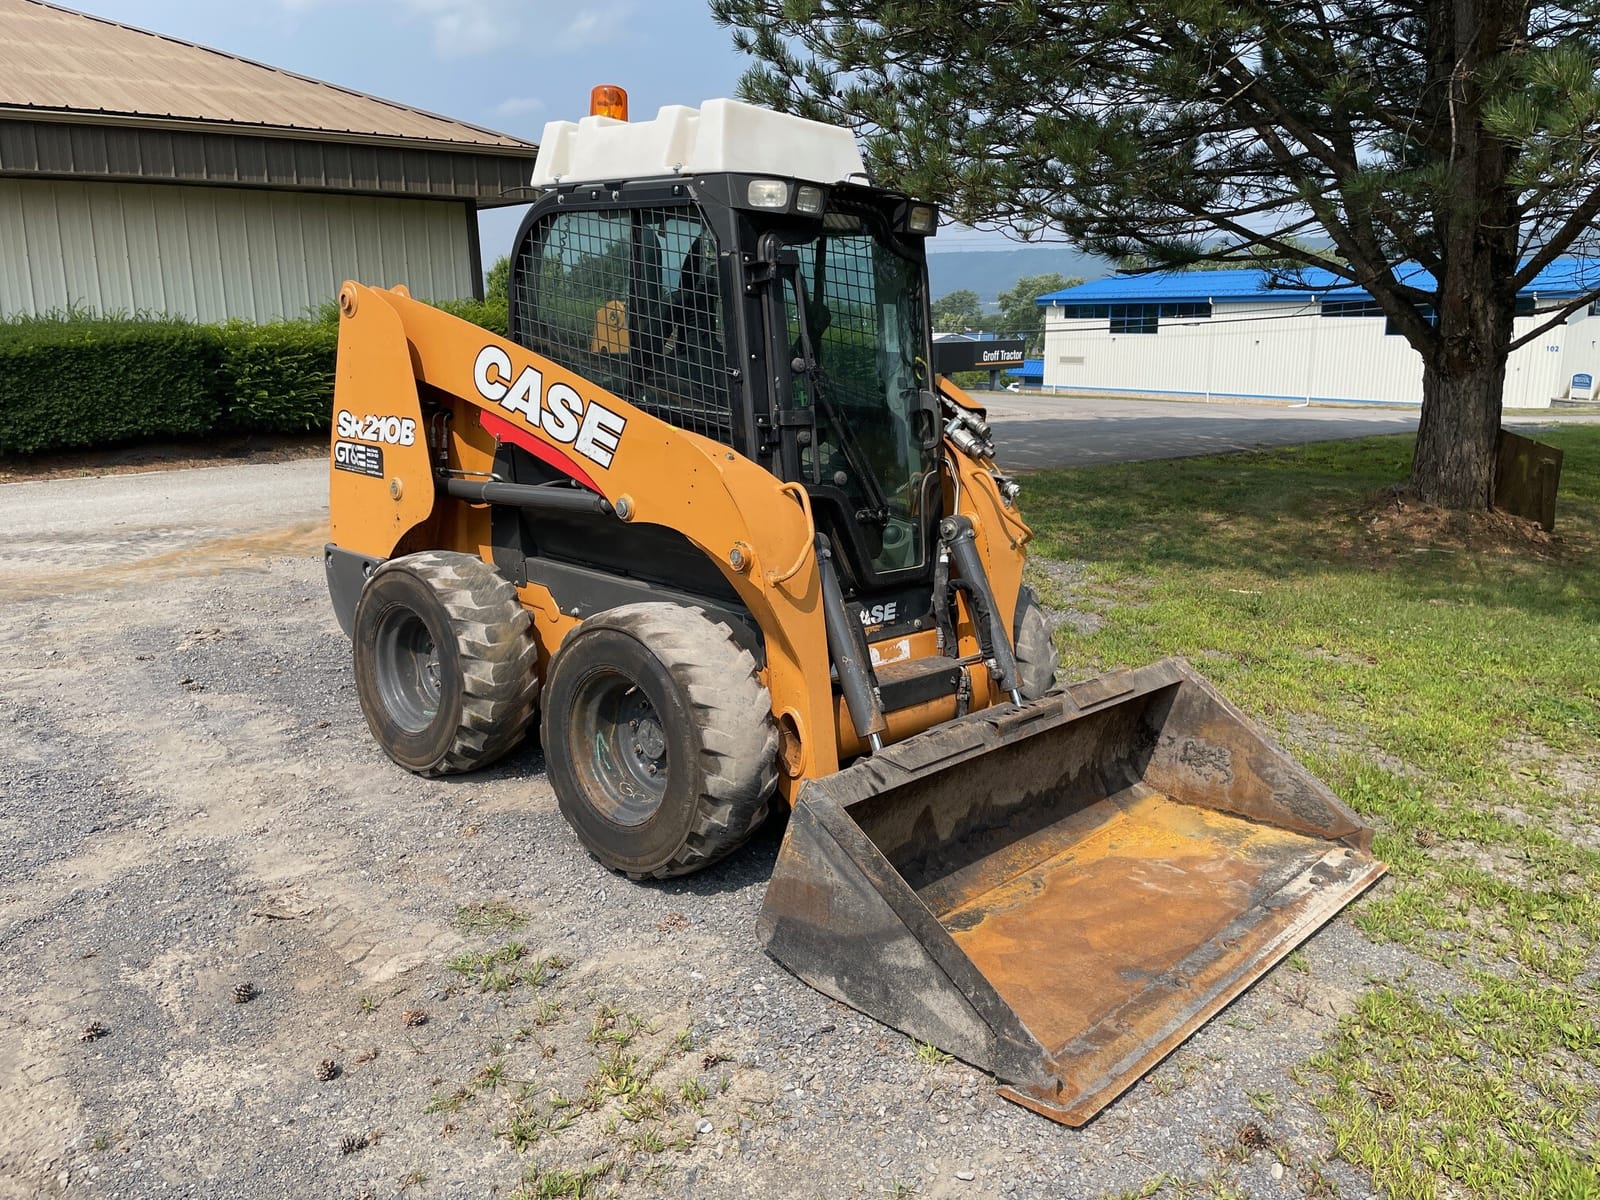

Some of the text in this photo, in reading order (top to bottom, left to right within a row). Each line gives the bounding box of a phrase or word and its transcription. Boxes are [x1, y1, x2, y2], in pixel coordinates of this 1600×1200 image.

[982, 349, 1023, 362] Groff Tractor
[1546, 345, 1559, 353] 102
[473, 344, 628, 470] CASE
